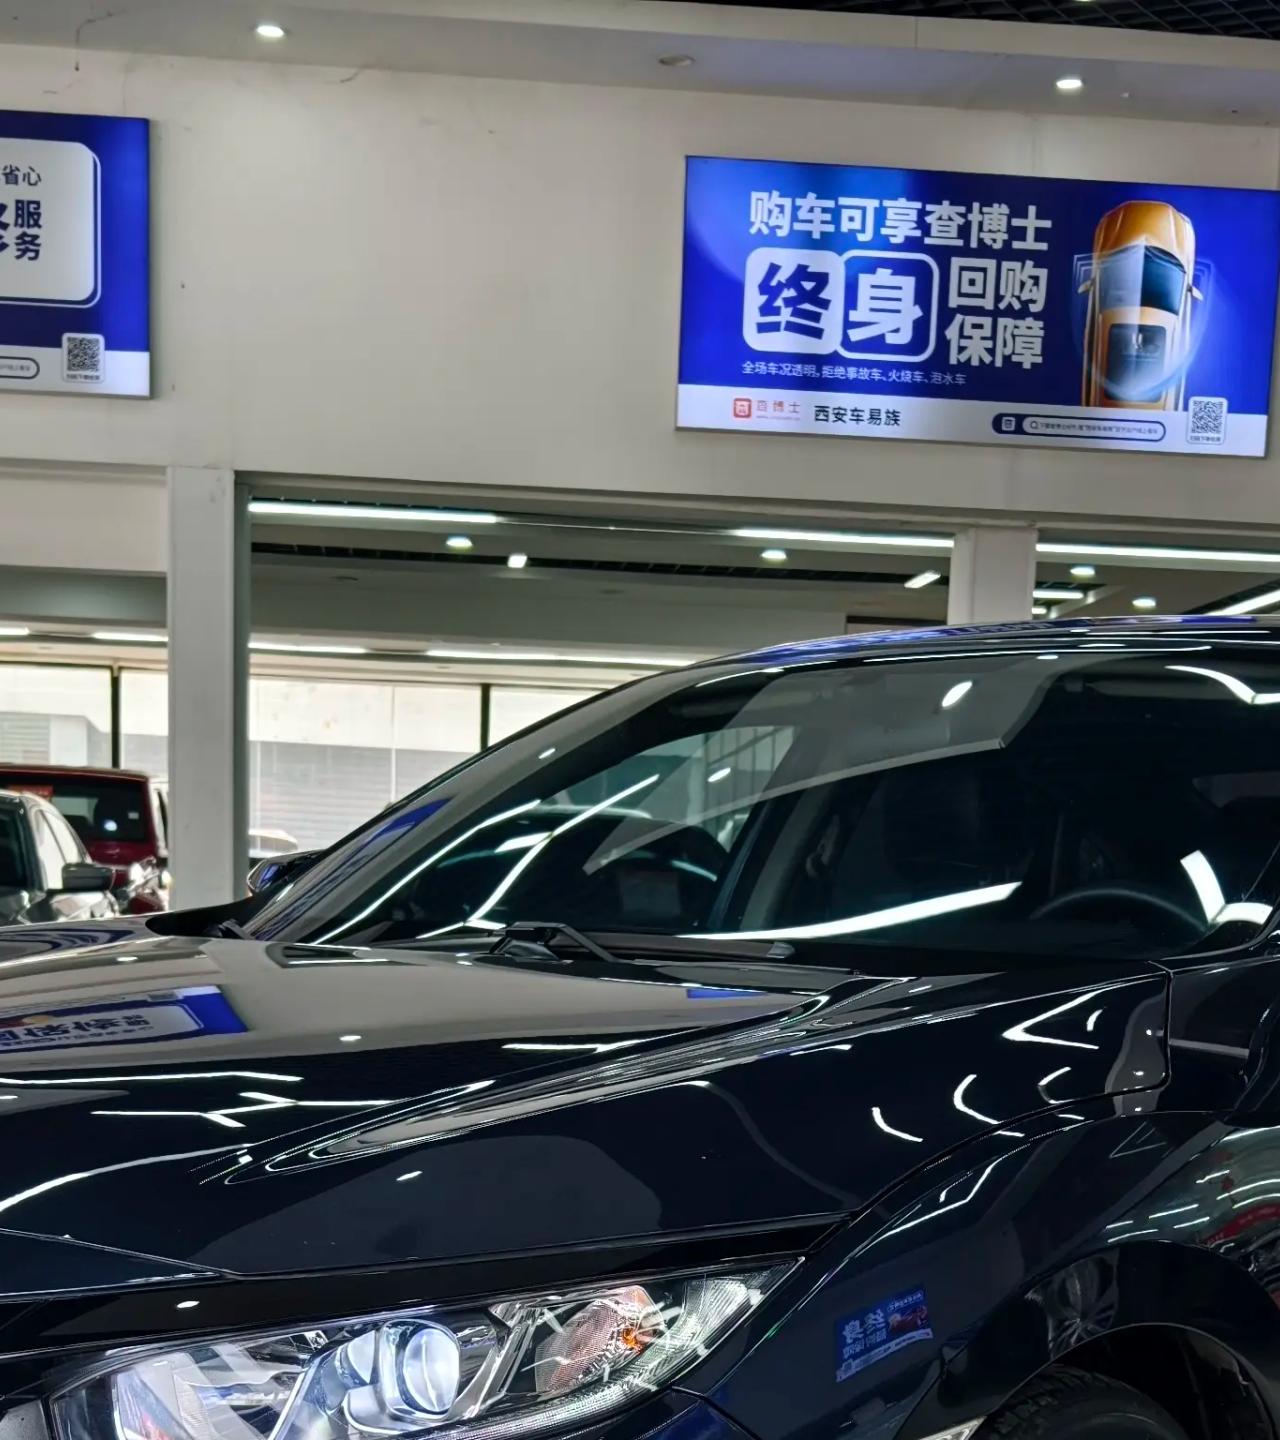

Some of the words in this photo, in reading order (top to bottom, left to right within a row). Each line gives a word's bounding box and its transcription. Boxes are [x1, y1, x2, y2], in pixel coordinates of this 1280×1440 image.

[748, 190, 1053, 251] 购车可享查博士
[756, 262, 924, 345] 终身
[948, 256, 1048, 313] 回购
[945, 314, 1046, 369] 保障
[814, 405, 902, 427] 西安车易族
